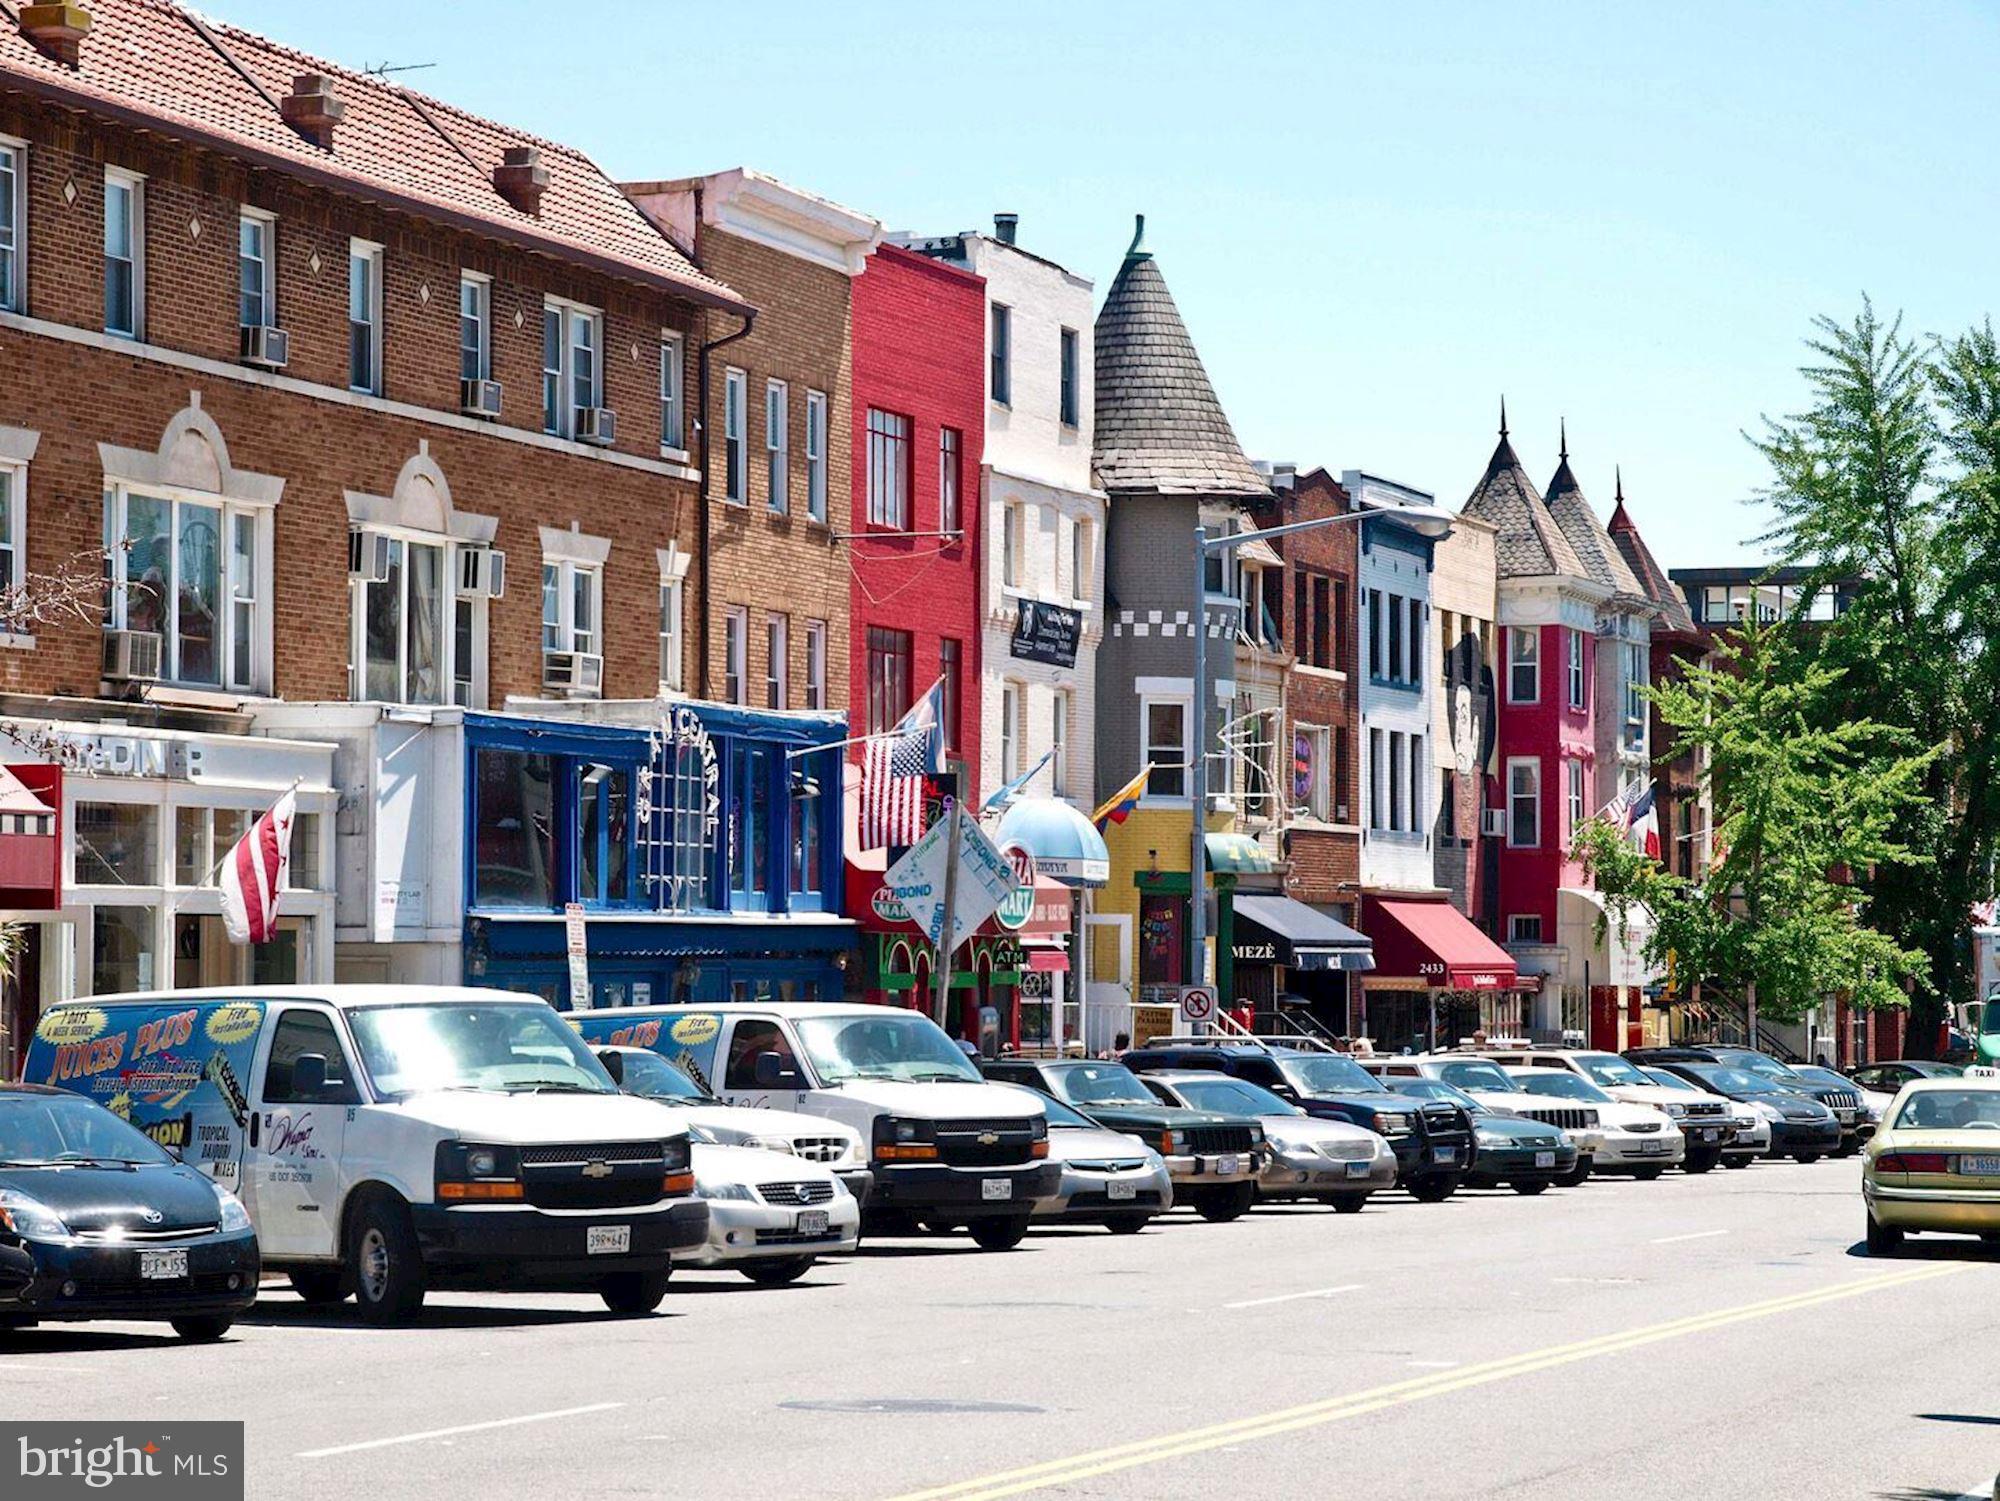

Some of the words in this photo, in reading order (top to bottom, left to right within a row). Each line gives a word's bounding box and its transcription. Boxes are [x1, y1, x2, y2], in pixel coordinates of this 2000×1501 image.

[877, 903, 909, 917] MAR
[996, 951, 1024, 963] ATM
[1419, 963, 1445, 974] 2433
[226, 1007, 249, 1021] Free
[688, 1017, 709, 1028] Free
[46, 1031, 128, 1085] JUICES
[131, 1008, 199, 1060] PLUS
[1974, 1069, 1995, 1078] TAXI
[197, 1124, 231, 1142] TROPICAL
[213, 1161, 237, 1178] MIXES
